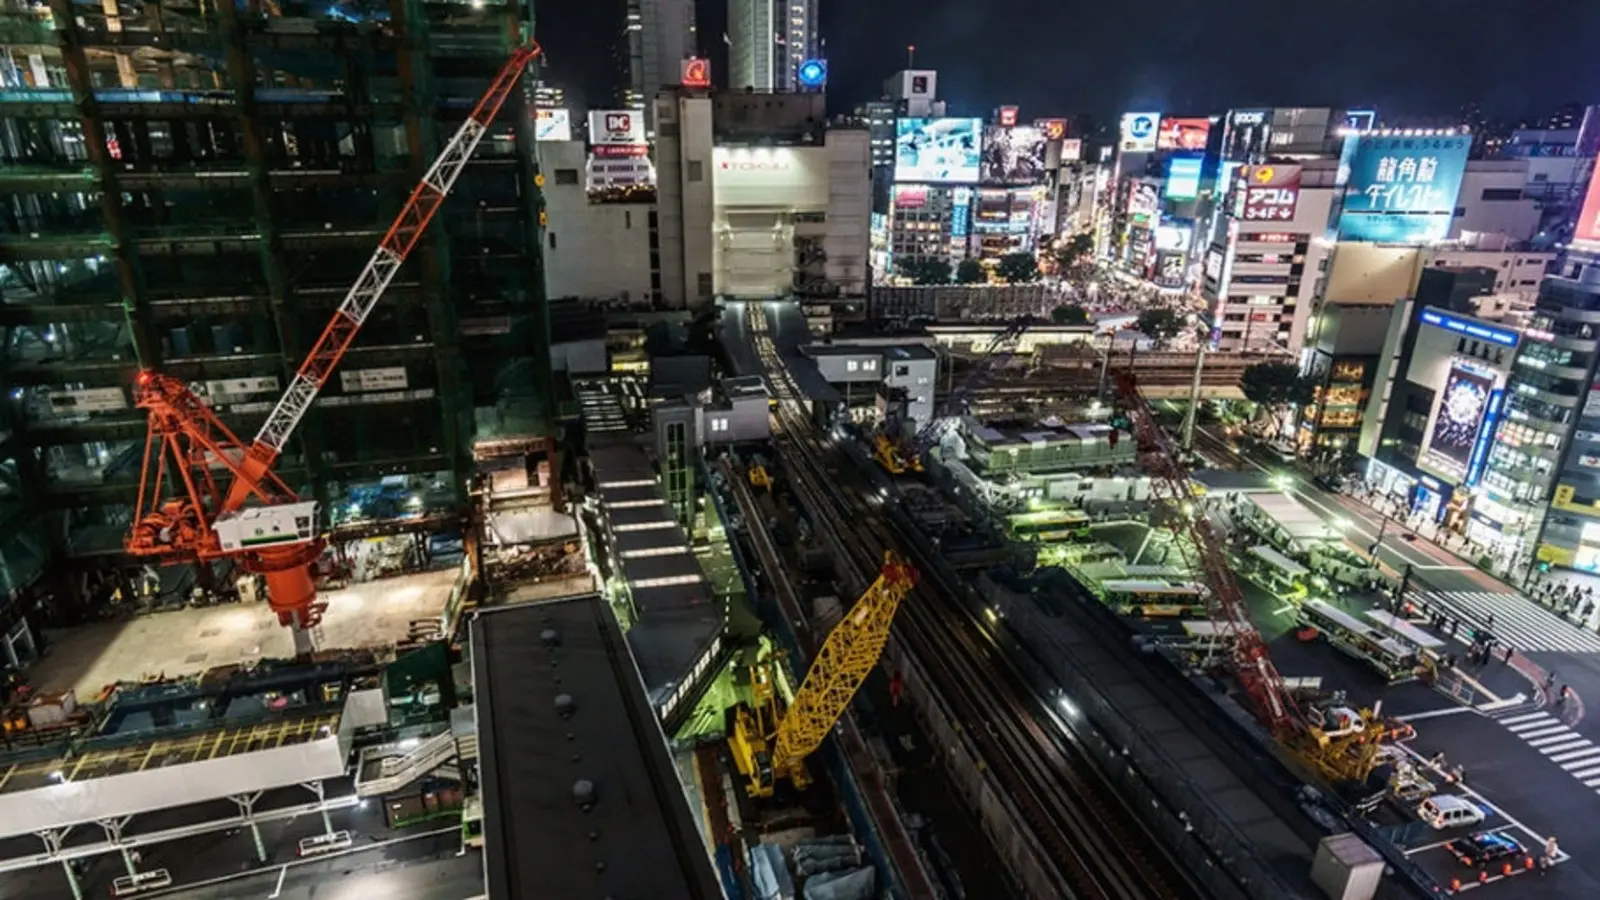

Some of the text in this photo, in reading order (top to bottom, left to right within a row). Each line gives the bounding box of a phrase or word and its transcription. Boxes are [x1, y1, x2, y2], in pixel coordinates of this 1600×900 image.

[1248, 188, 1294, 205] アコム
[1246, 206, 1278, 219] 3-4F
